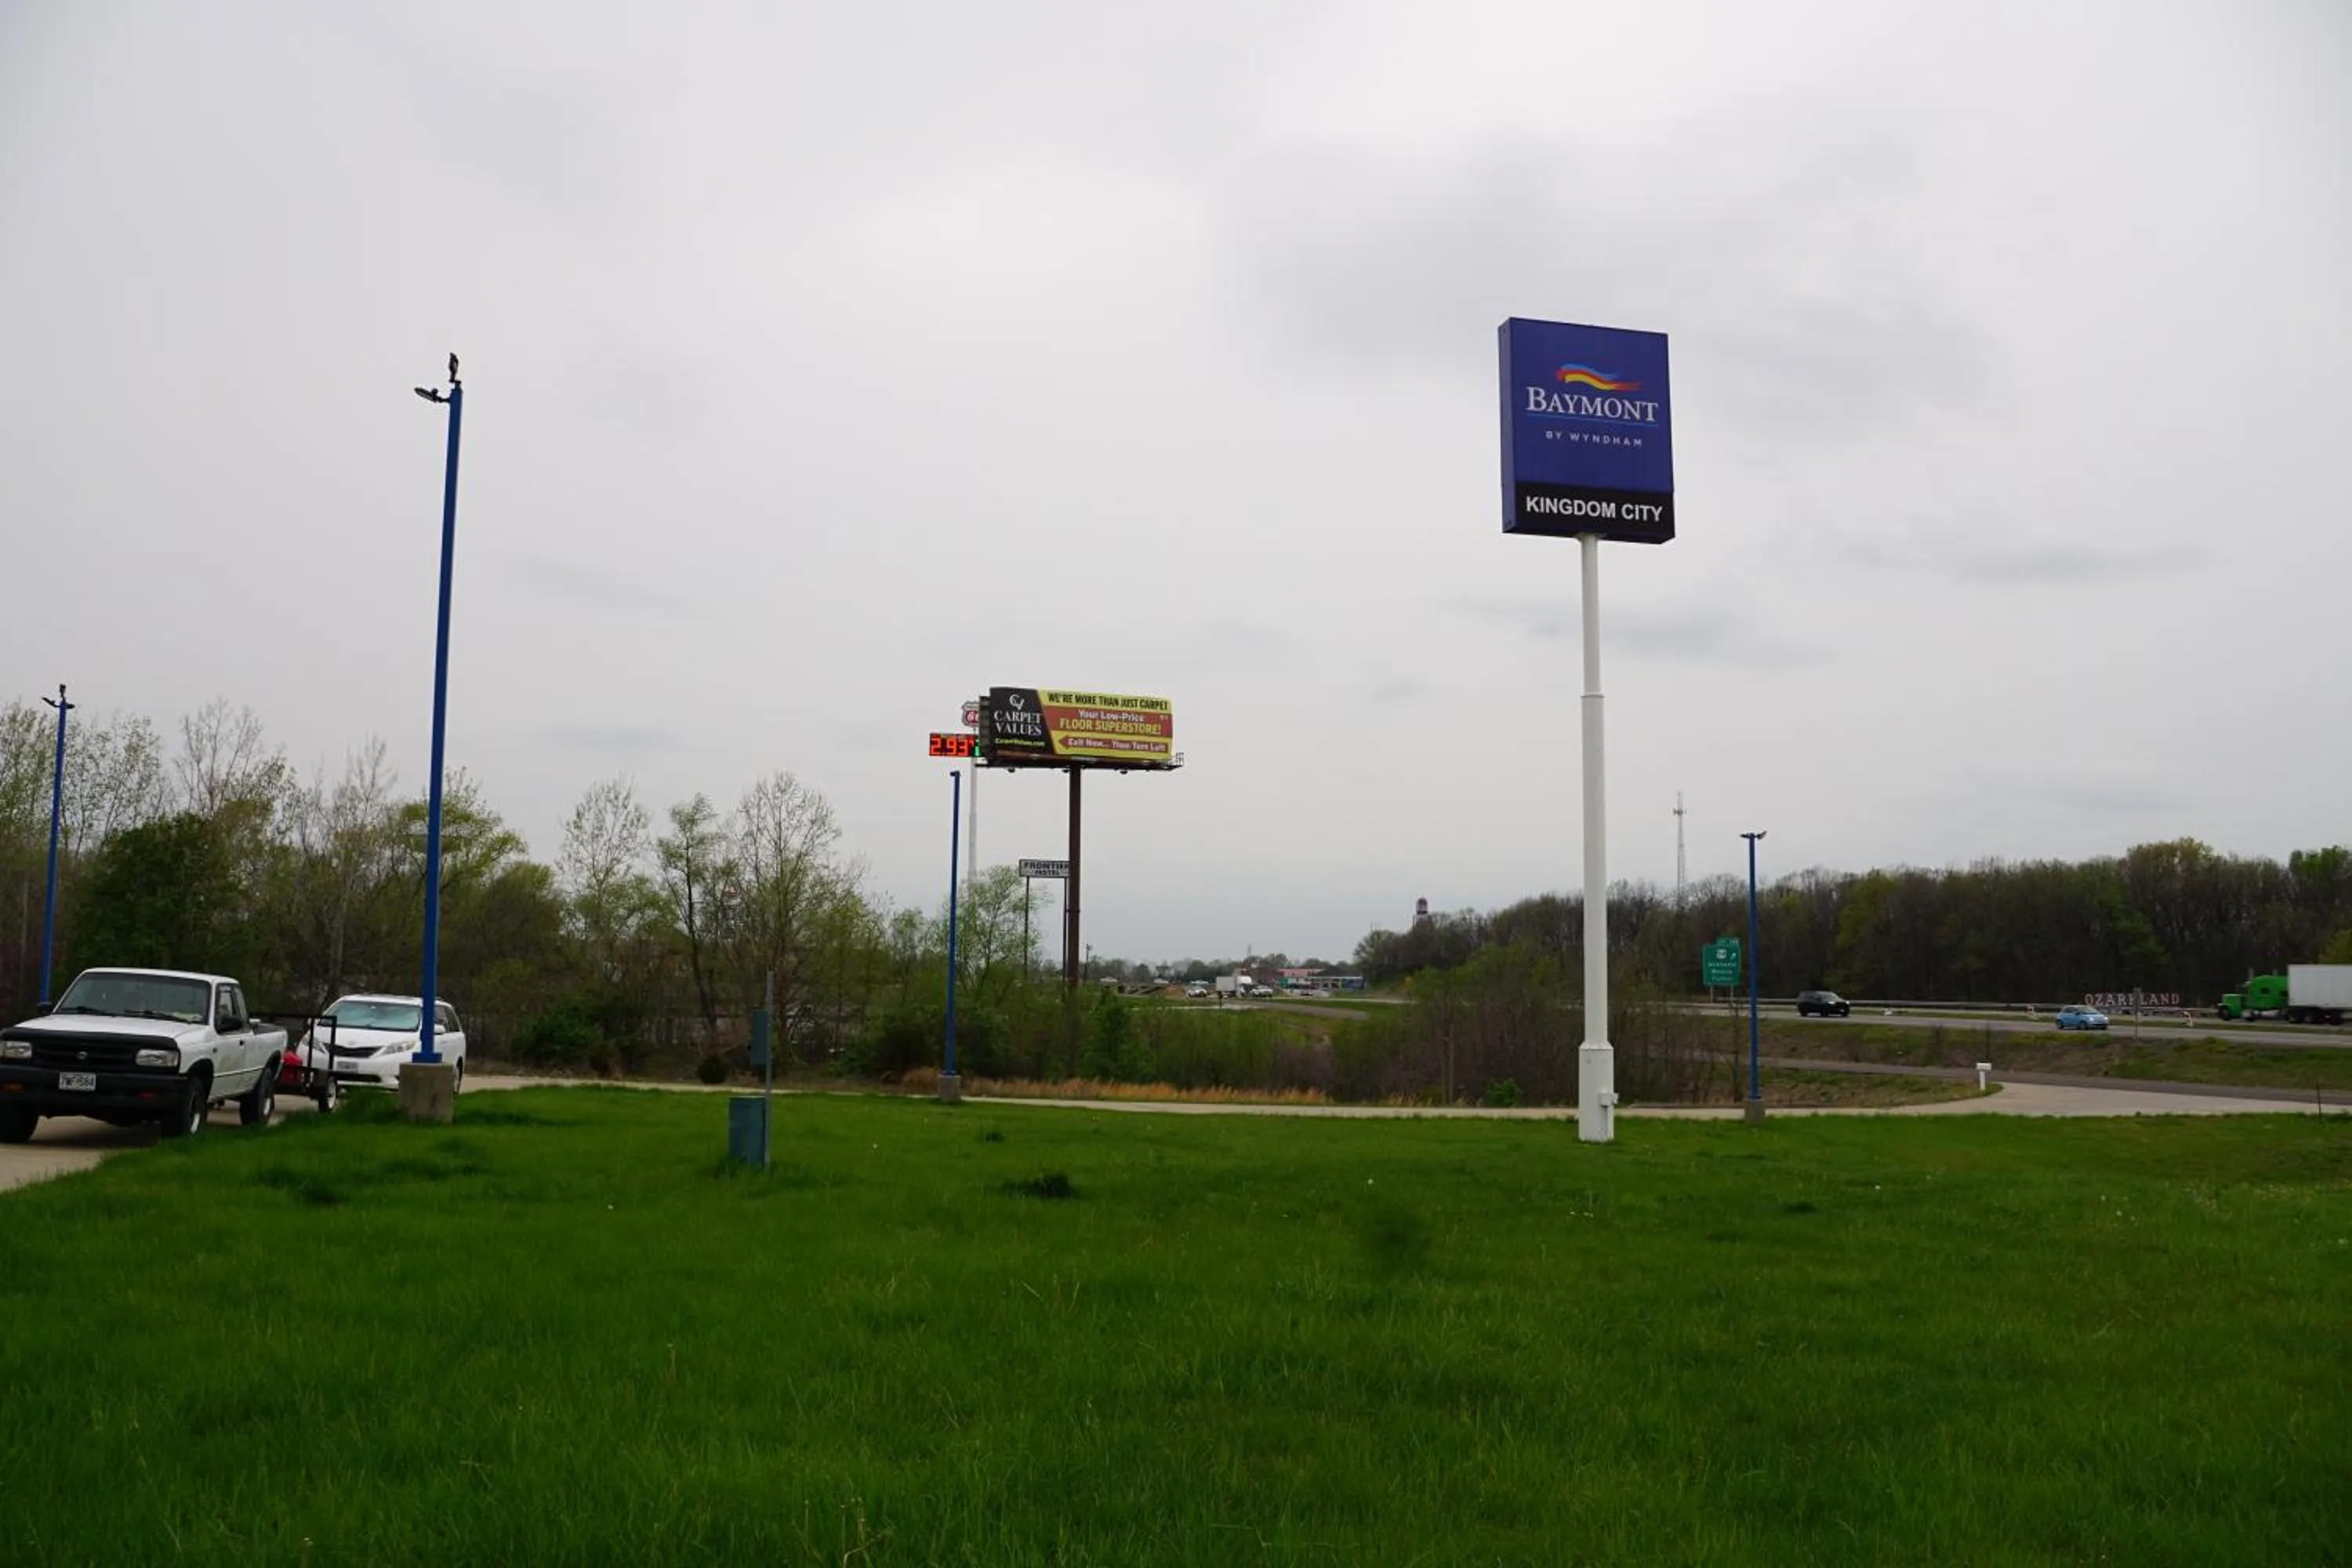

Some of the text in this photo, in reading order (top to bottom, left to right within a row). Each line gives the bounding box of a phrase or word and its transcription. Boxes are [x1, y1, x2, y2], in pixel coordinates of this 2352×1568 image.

[1526, 387, 1658, 421] BAYMONT
[1546, 431, 1643, 446] BY WYNDHAM
[1526, 496, 1663, 523] KINGDOM CITY
[1047, 692, 1168, 710] WE'RE MORE THAN JUST CARPET
[993, 710, 1042, 724] CARPET
[1078, 709, 1146, 722] Your Low-Price
[996, 722, 1042, 736] VALUES
[1060, 717, 1162, 735] FLOOR SUPERSTORE!
